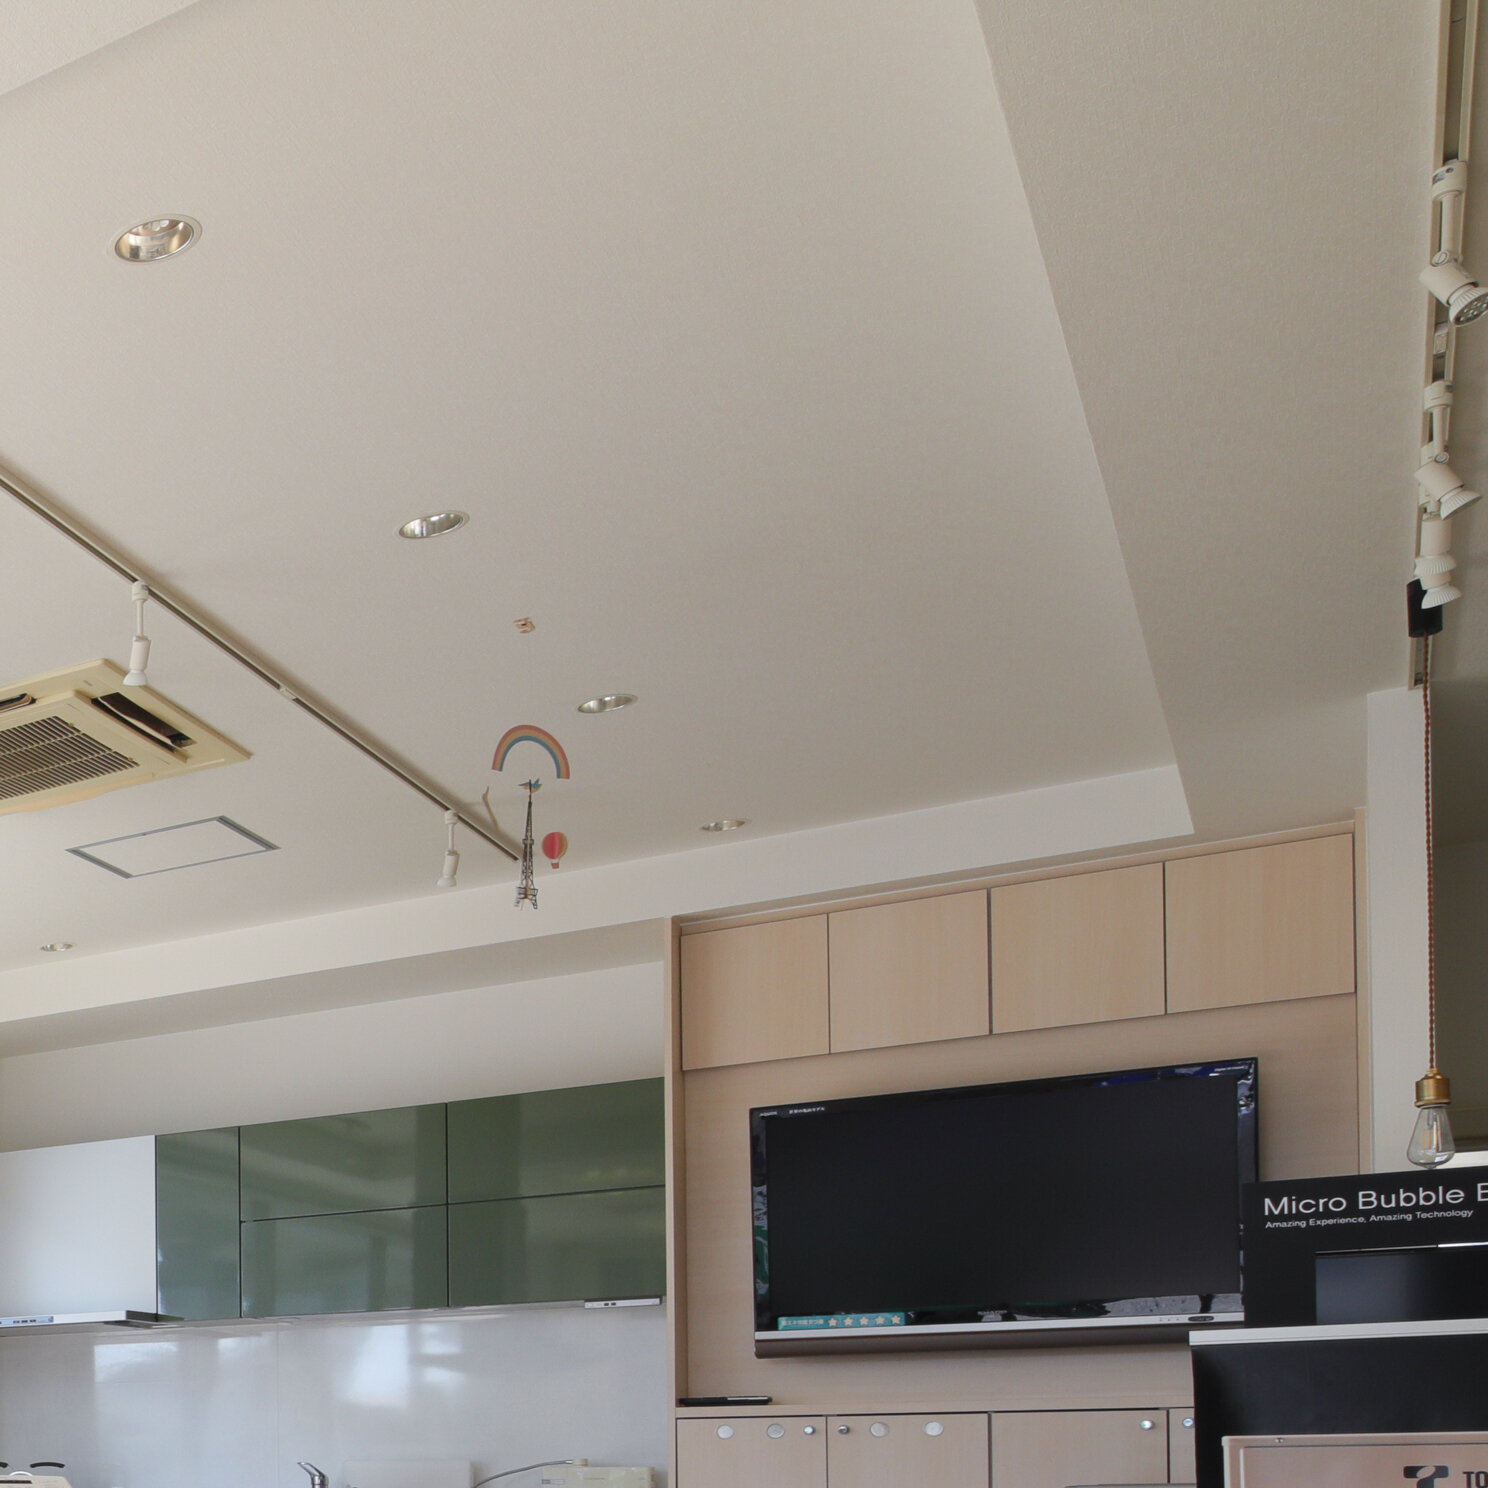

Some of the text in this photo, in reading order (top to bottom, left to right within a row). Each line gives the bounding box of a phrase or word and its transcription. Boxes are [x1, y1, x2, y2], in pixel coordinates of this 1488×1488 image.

[1264, 1196, 1347, 1216] Micro
[1358, 1185, 1465, 1210] Bubble
[1265, 1209, 1473, 1229] Amazing Experience, Amazing Technology
